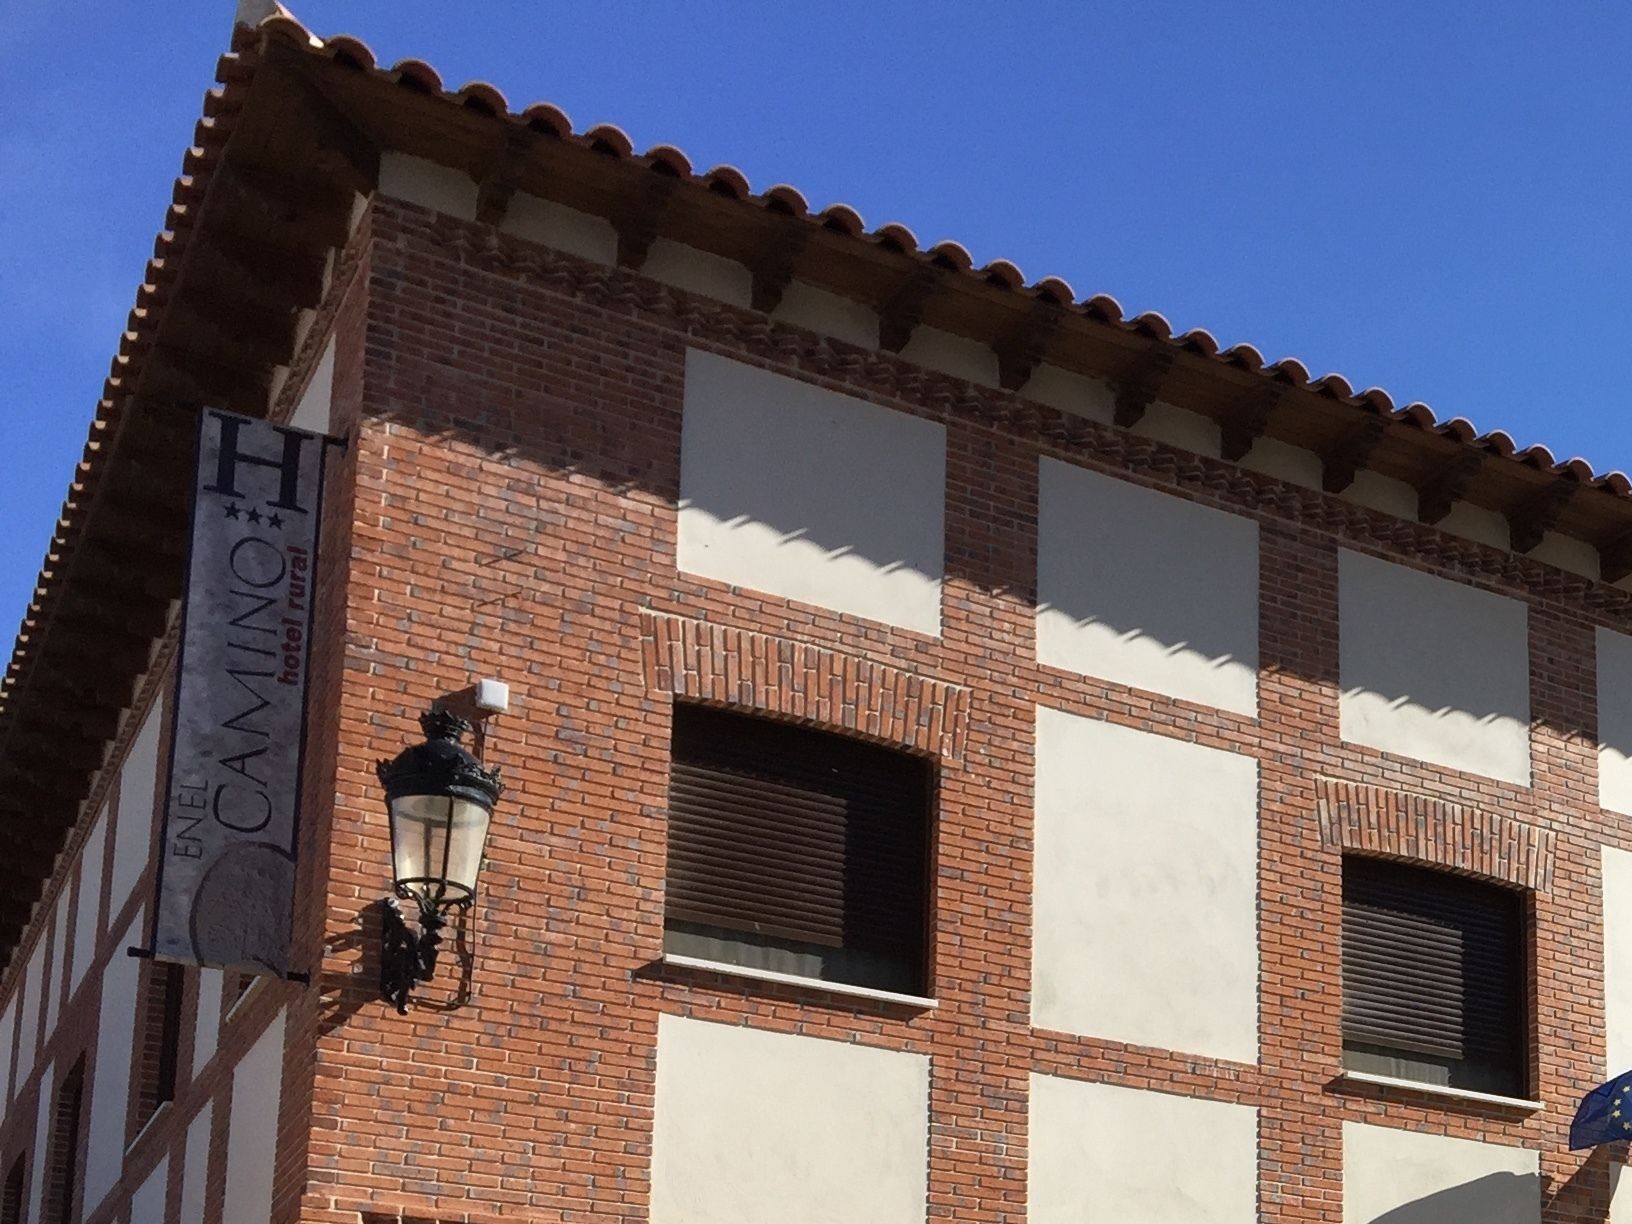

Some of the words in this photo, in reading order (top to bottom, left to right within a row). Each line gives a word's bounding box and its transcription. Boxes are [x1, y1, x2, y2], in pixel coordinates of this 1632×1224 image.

[203, 412, 314, 514] H
[287, 545, 310, 611] rural
[213, 537, 288, 834] CAMINO
[277, 617, 304, 688] hotel
